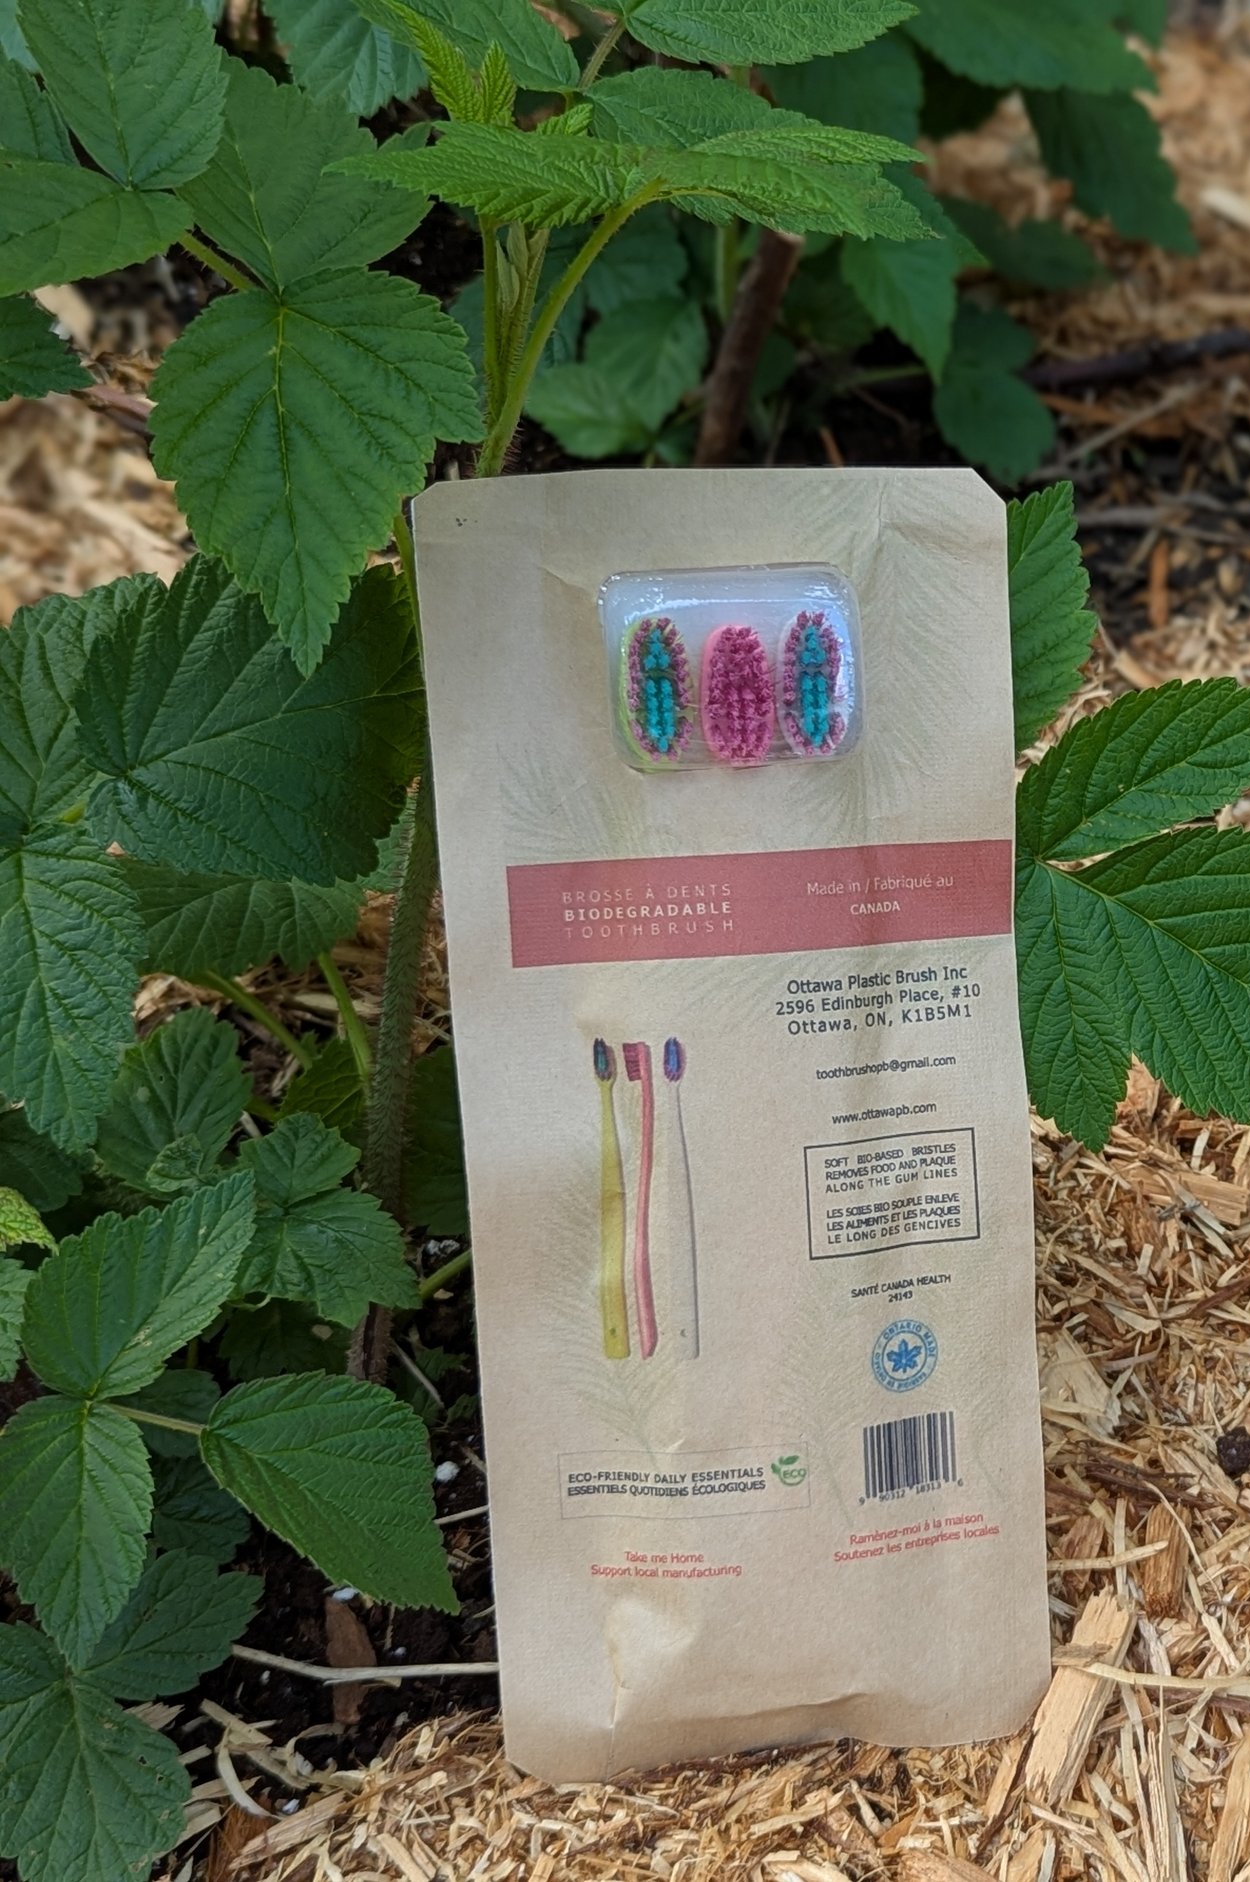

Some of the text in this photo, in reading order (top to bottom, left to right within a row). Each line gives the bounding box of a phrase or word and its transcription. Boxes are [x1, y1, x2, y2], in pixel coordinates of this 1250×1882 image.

[562, 883, 731, 904] BROSSE À DENTS
[807, 874, 953, 895] Made in / Fabriqué au
[564, 902, 732, 922] BIODEGRADABLE
[850, 901, 901, 915] CANADA
[564, 919, 733, 939] TOOTHBRUSH
[787, 966, 968, 994] Ottawa Plastic Brush Inc
[775, 983, 980, 1016] 2596 Edinburgh Place, #10
[787, 1004, 972, 1035] Ottawa, ON, K1B5M1
[816, 1056, 956, 1080] toothbrushopb@gmail.com
[832, 1103, 937, 1124] www.ottawapb.com
[824, 1143, 956, 1168] SOFT BIO-BASED BRISTLES
[825, 1155, 956, 1180] REMOVES FOOD AND PLAQUE
[825, 1168, 958, 1193] ALONG THE GUM LINES
[826, 1208, 843, 1219] LES
[873, 1202, 890, 1213] BIO
[891, 1195, 923, 1210] SOUPLE
[925, 1193, 959, 1204] ENLEVE
[826, 1205, 961, 1231] LES ALIMENTS ET LES PLAQUES
[828, 1218, 961, 1244] LE LONG DES GENCIVES
[851, 1274, 951, 1298] SANTÉ CANADA HEALTH
[568, 1467, 764, 1484] ECO-FRIENDLY DAILY ESSENTIALS
[782, 1468, 807, 1479] ECO
[567, 1480, 766, 1497] ESSENTIELS QUOTIDIENS ÉCOLOGIQUES
[850, 1522, 921, 1545] Ramènez-moi
[933, 1518, 942, 1529] la
[945, 1513, 984, 1526] maison
[833, 1524, 1000, 1562] Soutenez les entreprises locales
[624, 1551, 704, 1563] Take me Home
[591, 1564, 742, 1578] Support local manufacturing
